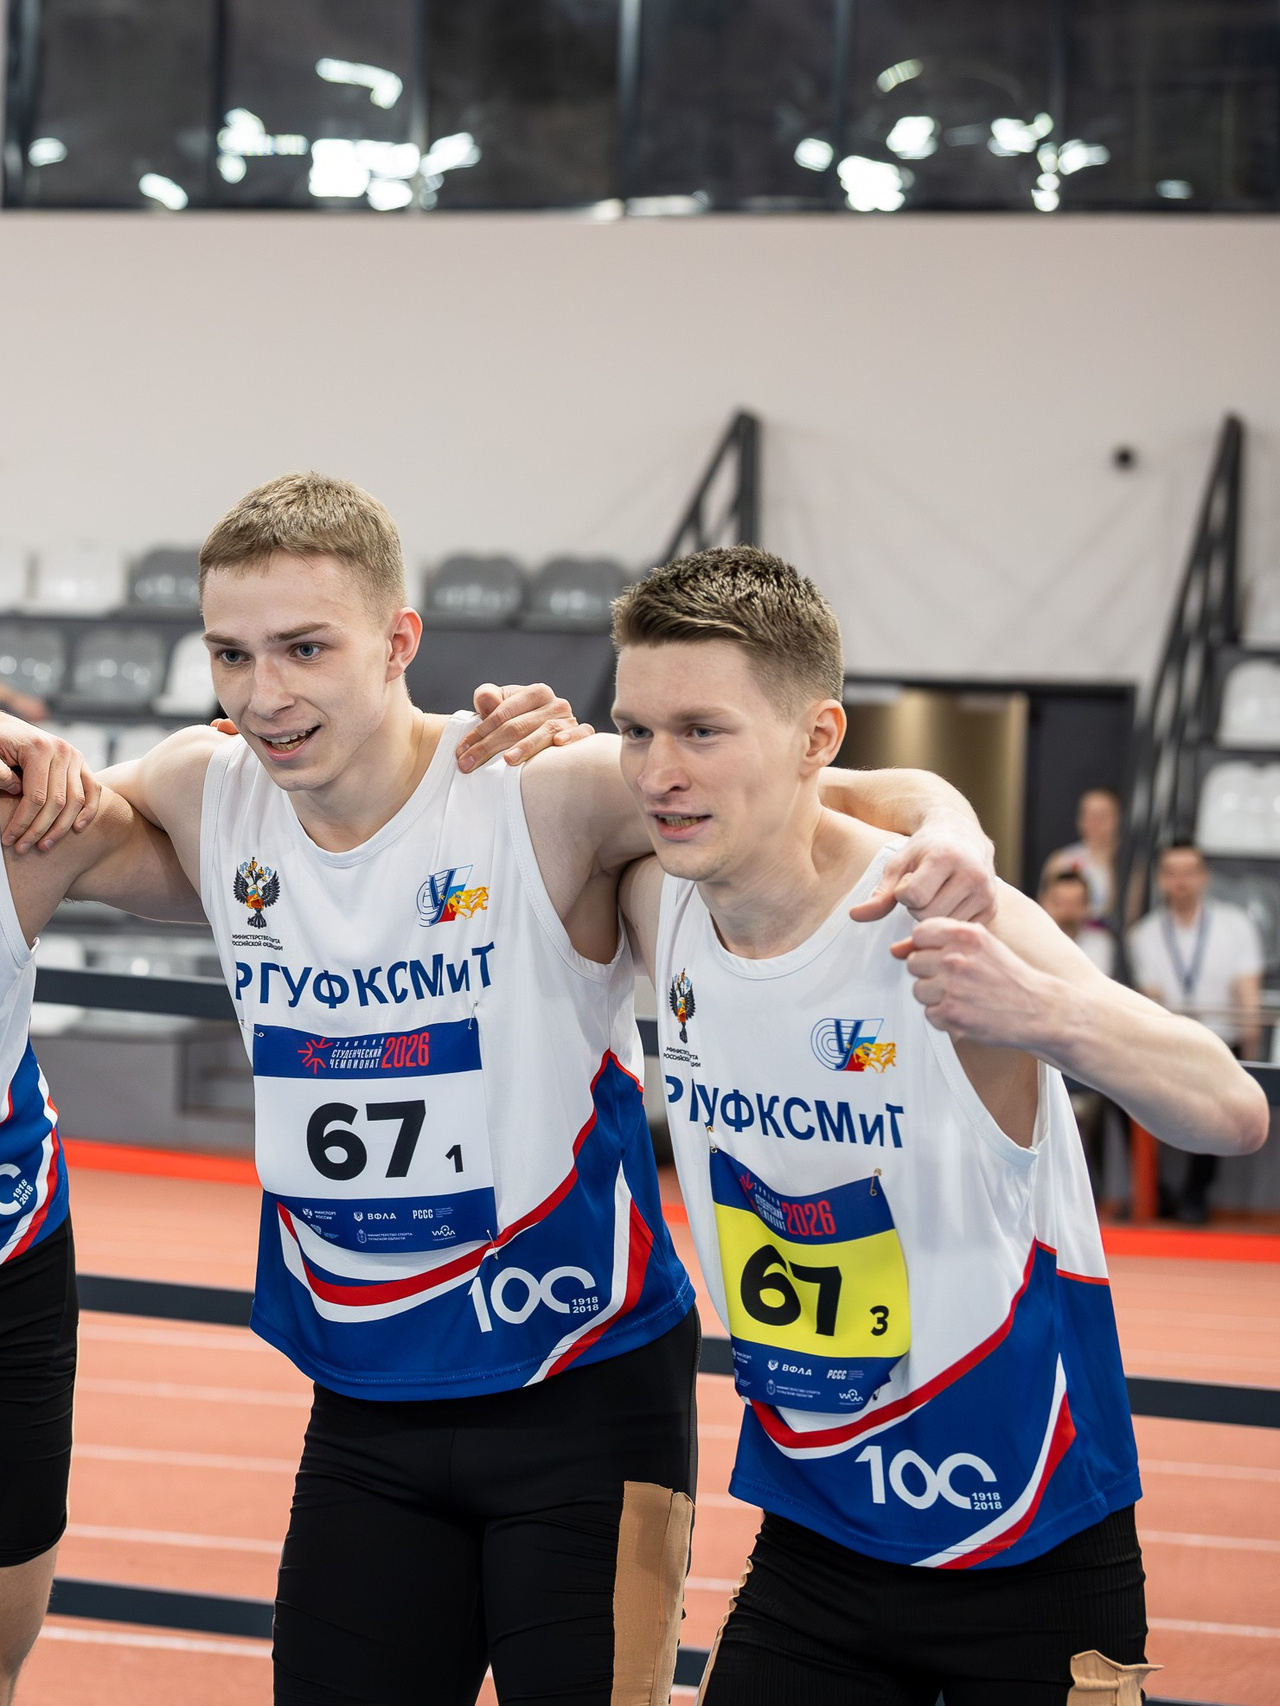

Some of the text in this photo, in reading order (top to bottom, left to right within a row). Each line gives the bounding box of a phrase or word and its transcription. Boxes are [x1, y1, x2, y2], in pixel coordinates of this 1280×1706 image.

[235, 941, 496, 1009] РГУФКСМиТ
[331, 1046, 382, 1059] СТУДЕНЧЕСКИЙ
[381, 1032, 430, 1069] 2026
[329, 1058, 380, 1069] ЧЕМПИОНАТ
[306, 1100, 464, 1181] 67 1
[13, 1179, 28, 1199] 1918
[19, 1185, 34, 1206] 2018
[367, 1212, 397, 1221] ВФЛА
[412, 1208, 434, 1220] РССС
[781, 1200, 837, 1236] 2026
[740, 1244, 889, 1336] 67 3
[571, 1296, 598, 1306] 1918
[572, 1304, 600, 1314] 2018
[782, 1363, 812, 1376] ВФЛА
[826, 1369, 847, 1380] РССС
[972, 1492, 1001, 1501] 1918
[973, 1501, 1003, 1511] 2018
